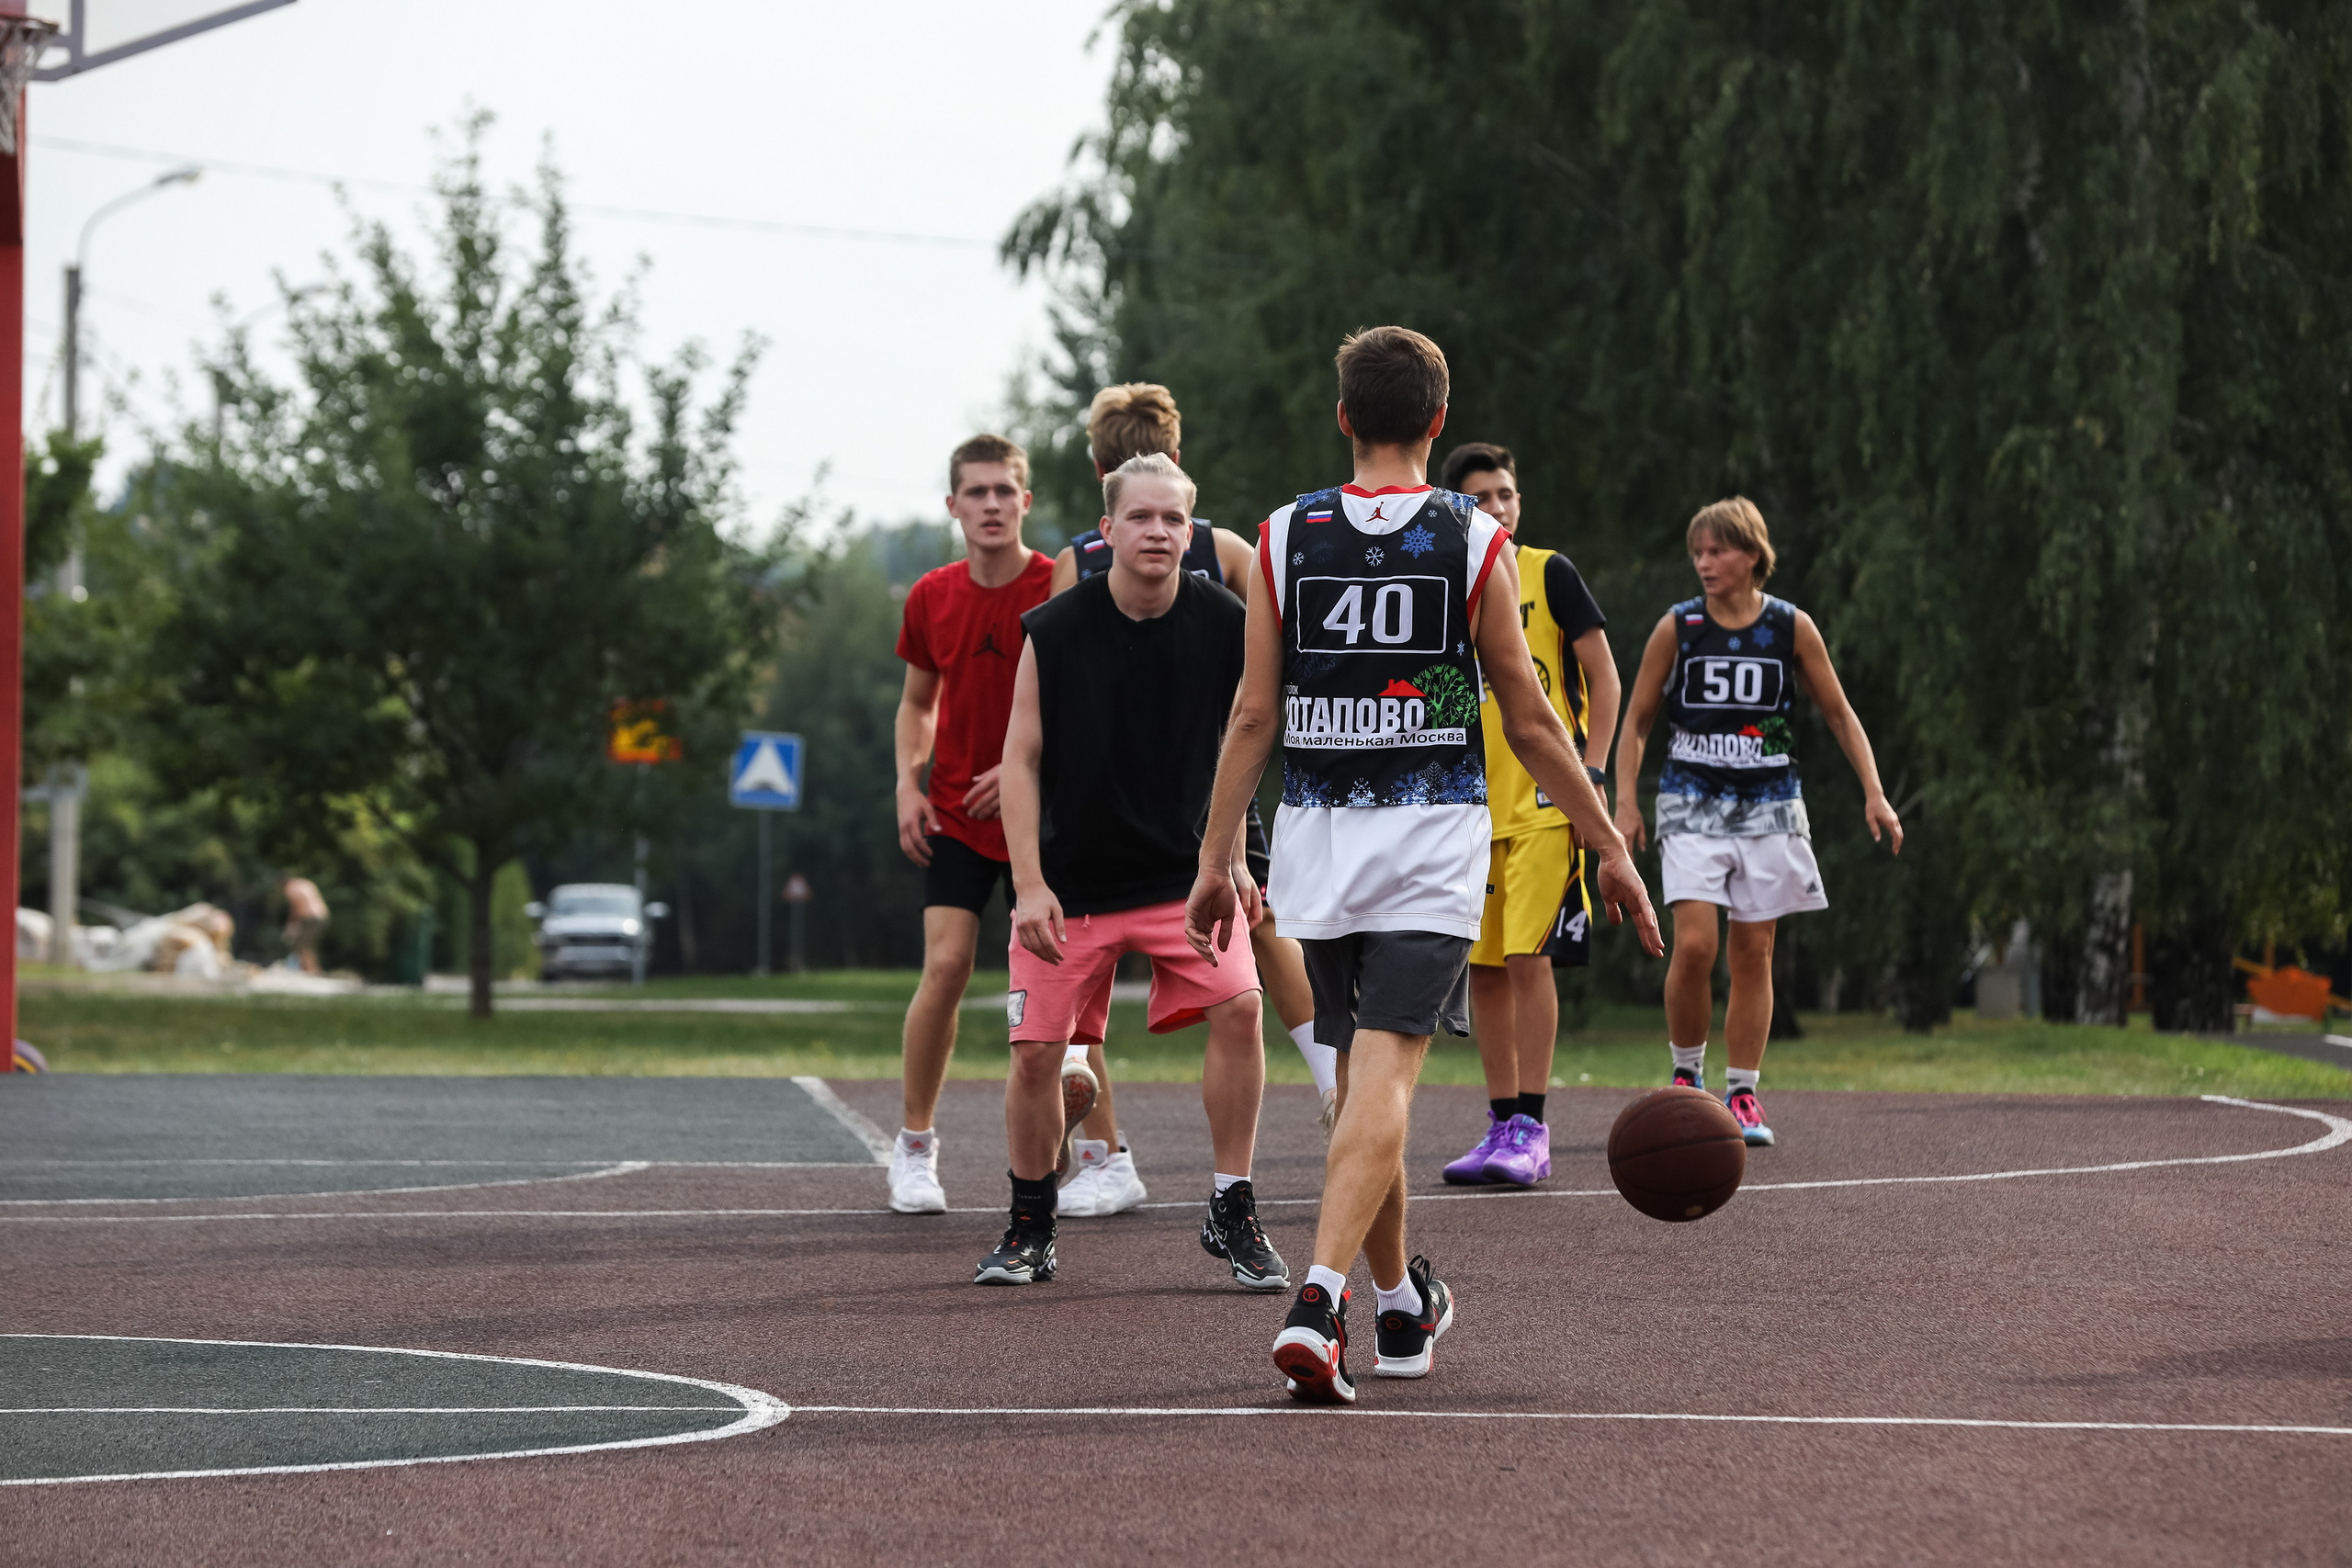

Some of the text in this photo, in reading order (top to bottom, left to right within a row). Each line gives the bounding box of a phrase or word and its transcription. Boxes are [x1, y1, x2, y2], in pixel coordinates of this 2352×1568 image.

[1322, 583, 1414, 645] 40
[1702, 660, 1763, 704] 50
[1303, 737, 1395, 747] маленькая
[1400, 732, 1464, 745] Москва
[1556, 906, 1587, 942] 14
